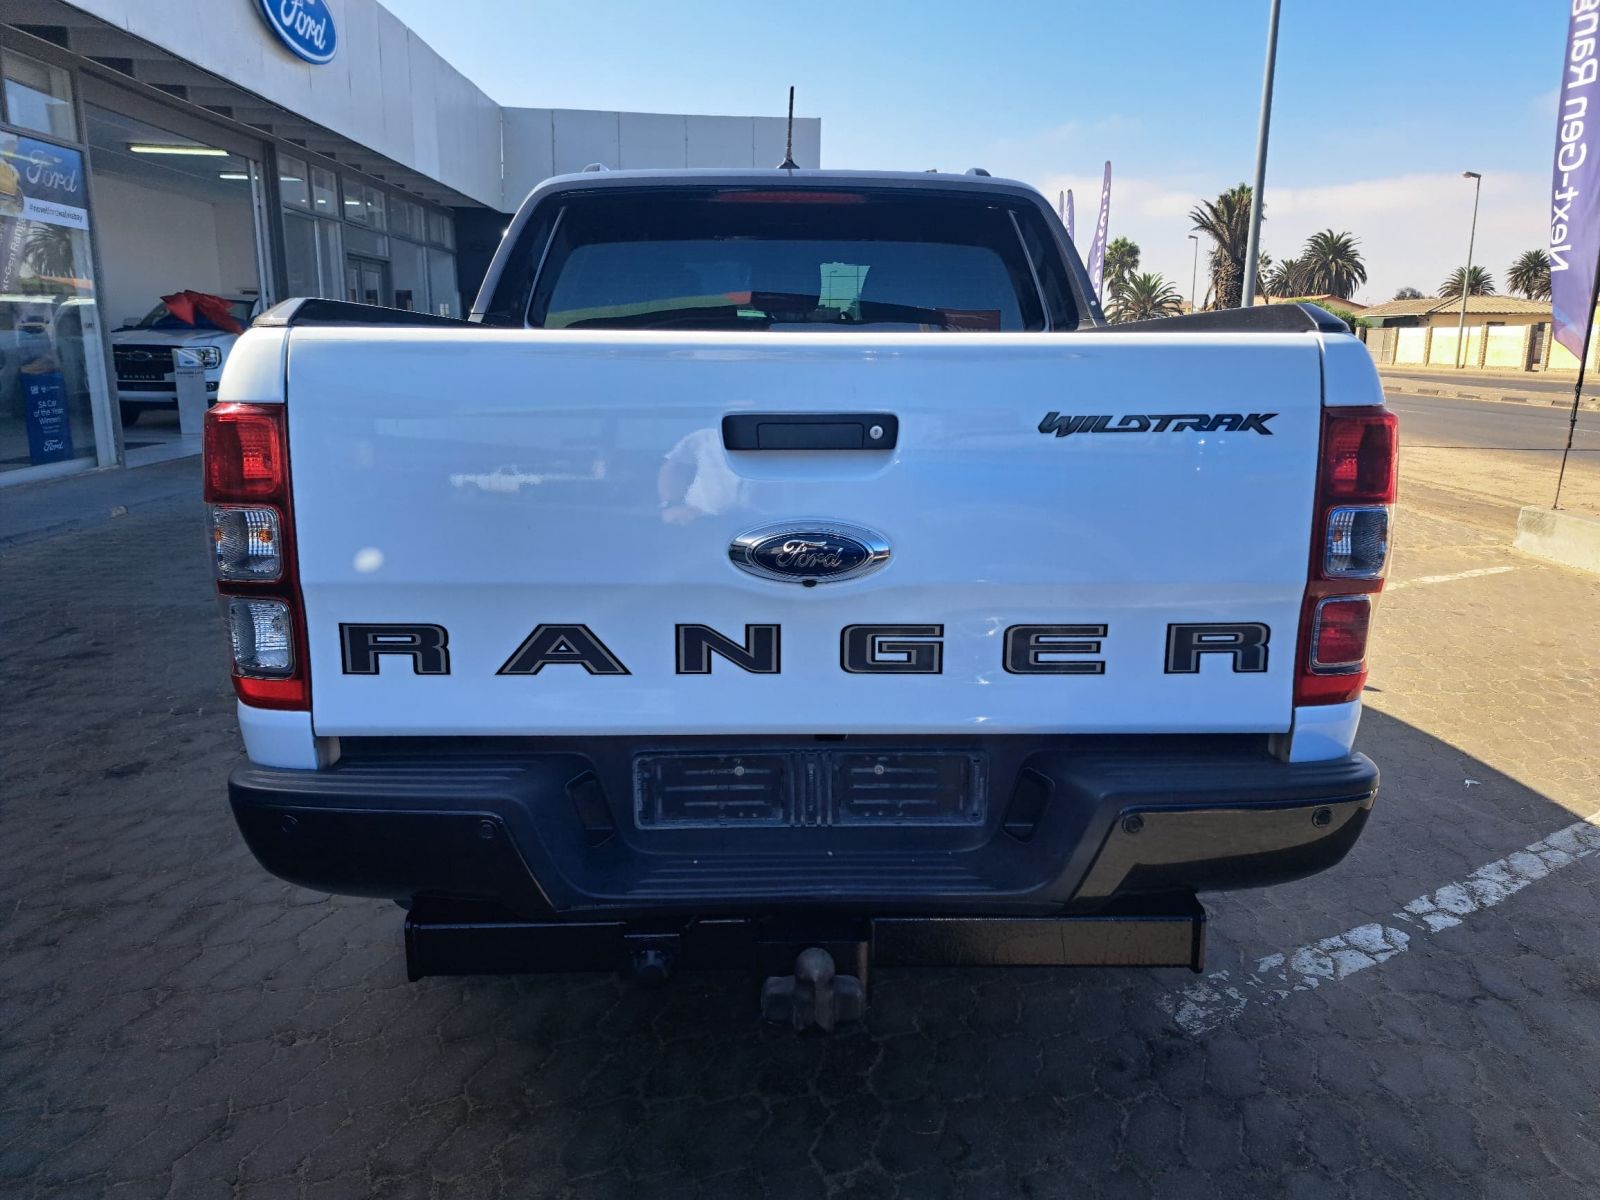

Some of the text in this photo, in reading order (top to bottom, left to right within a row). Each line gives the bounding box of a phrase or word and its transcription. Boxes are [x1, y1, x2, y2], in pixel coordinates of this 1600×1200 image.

[280, 0, 326, 50] Ford
[26, 150, 78, 193] Ford
[1038, 411, 1279, 437] WILDTRAK
[43, 439, 64, 452] Ford
[775, 539, 844, 568] Ford
[338, 622, 1271, 676] RANGER
